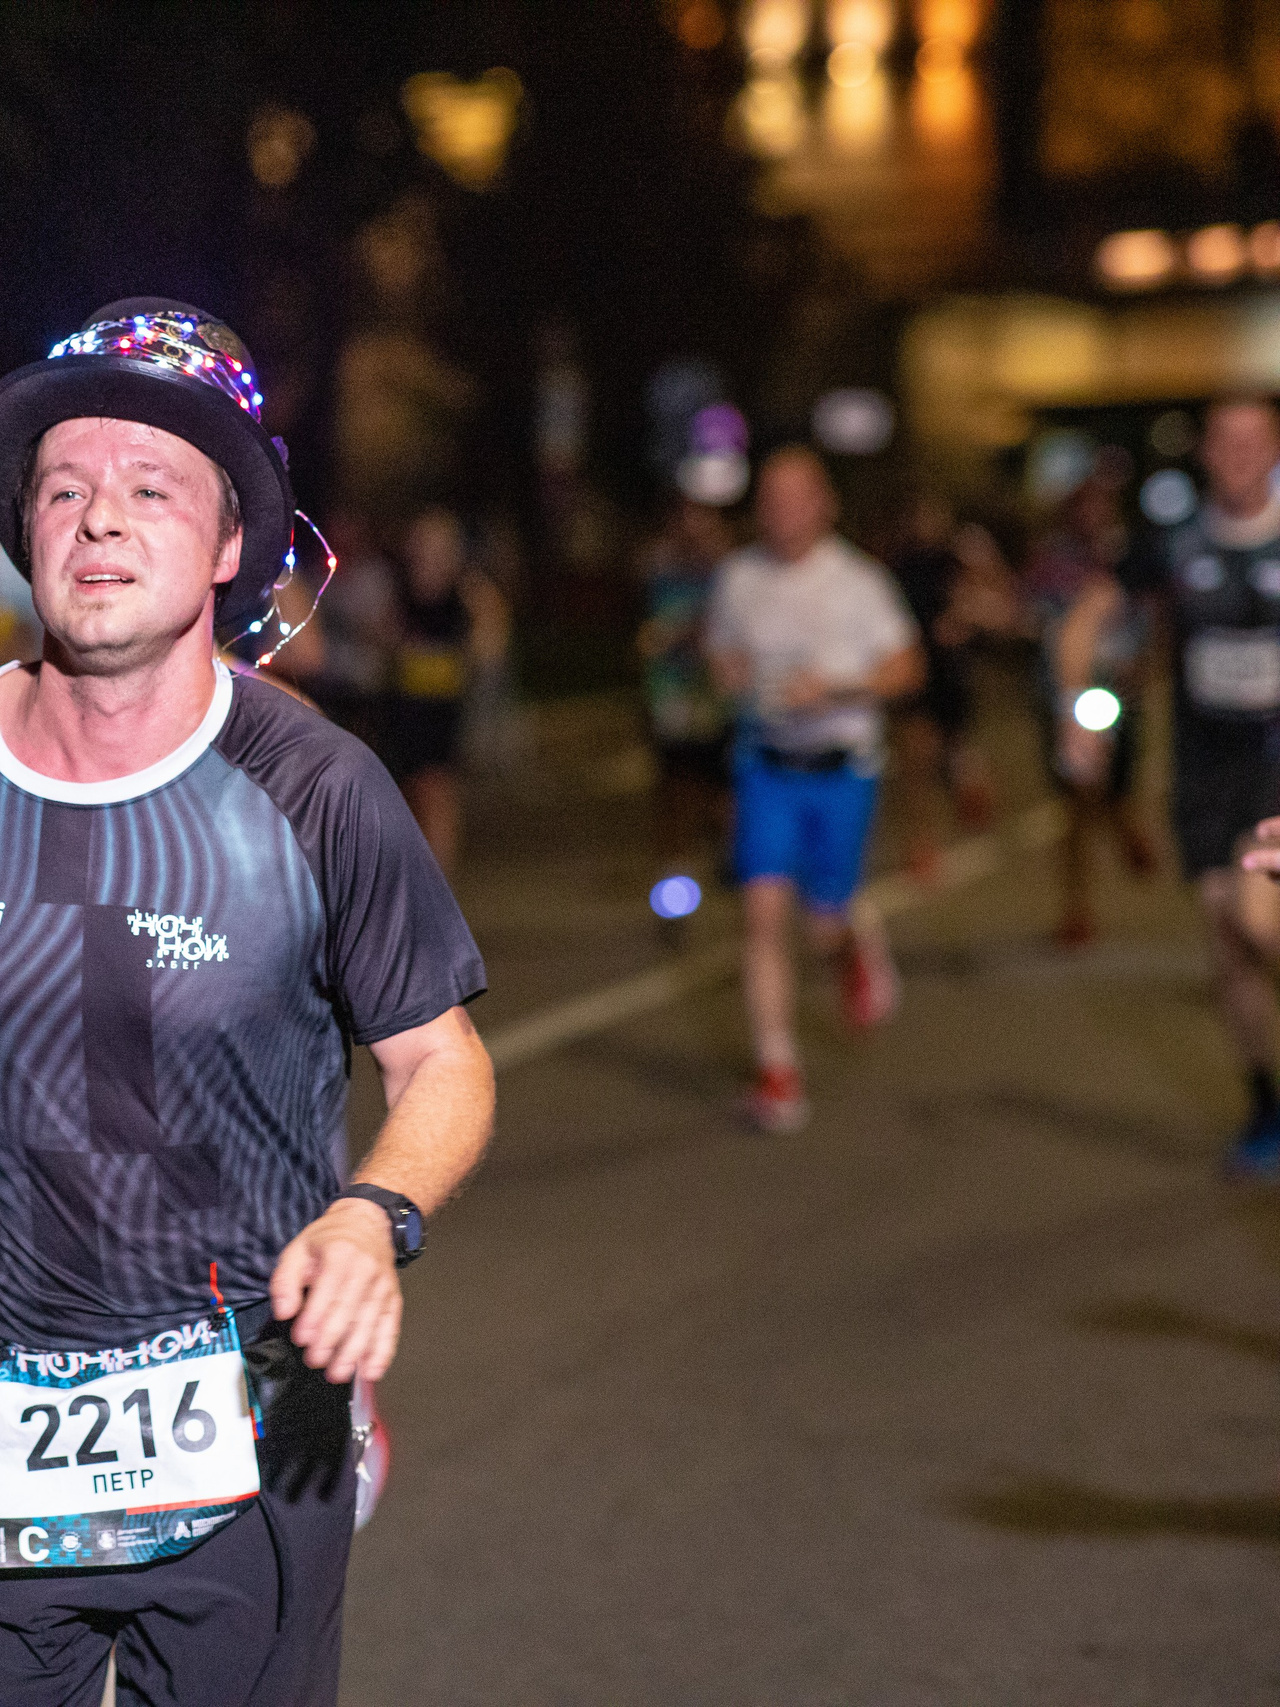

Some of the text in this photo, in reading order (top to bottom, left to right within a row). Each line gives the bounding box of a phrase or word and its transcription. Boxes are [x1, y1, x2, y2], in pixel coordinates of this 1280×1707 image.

[146, 959, 200, 970] ЗАБЕГ
[20, 1380, 217, 1472] 2216
[93, 1469, 154, 1494] ПЕТР
